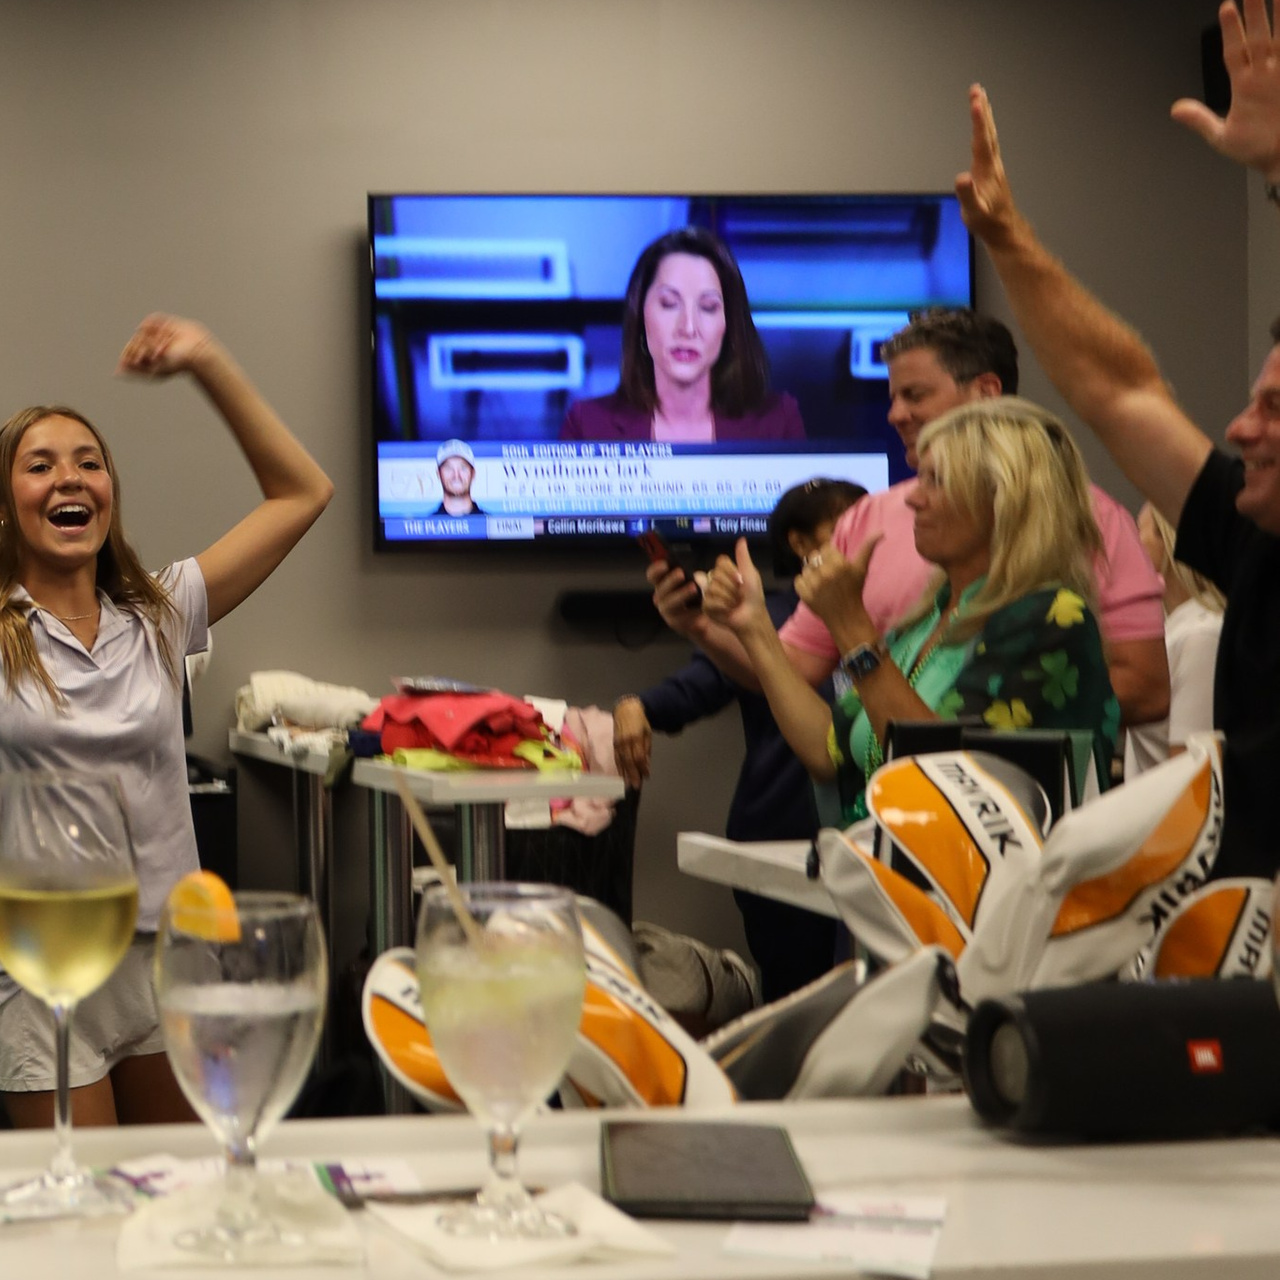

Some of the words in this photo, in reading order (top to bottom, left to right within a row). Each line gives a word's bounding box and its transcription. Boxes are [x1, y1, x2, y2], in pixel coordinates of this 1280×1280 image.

[533, 444, 577, 458] EDITION
[581, 443, 597, 458] OF
[599, 443, 621, 458] THE
[625, 443, 673, 458] PLAYERS
[502, 461, 598, 481] Wyndham
[603, 459, 651, 478] Clark
[404, 520, 426, 534] THE
[426, 520, 470, 534] PLAYERS
[548, 519, 576, 535] Collin
[577, 519, 625, 534] Morikawa
[714, 517, 738, 534] Tony
[740, 517, 767, 532] Finau
